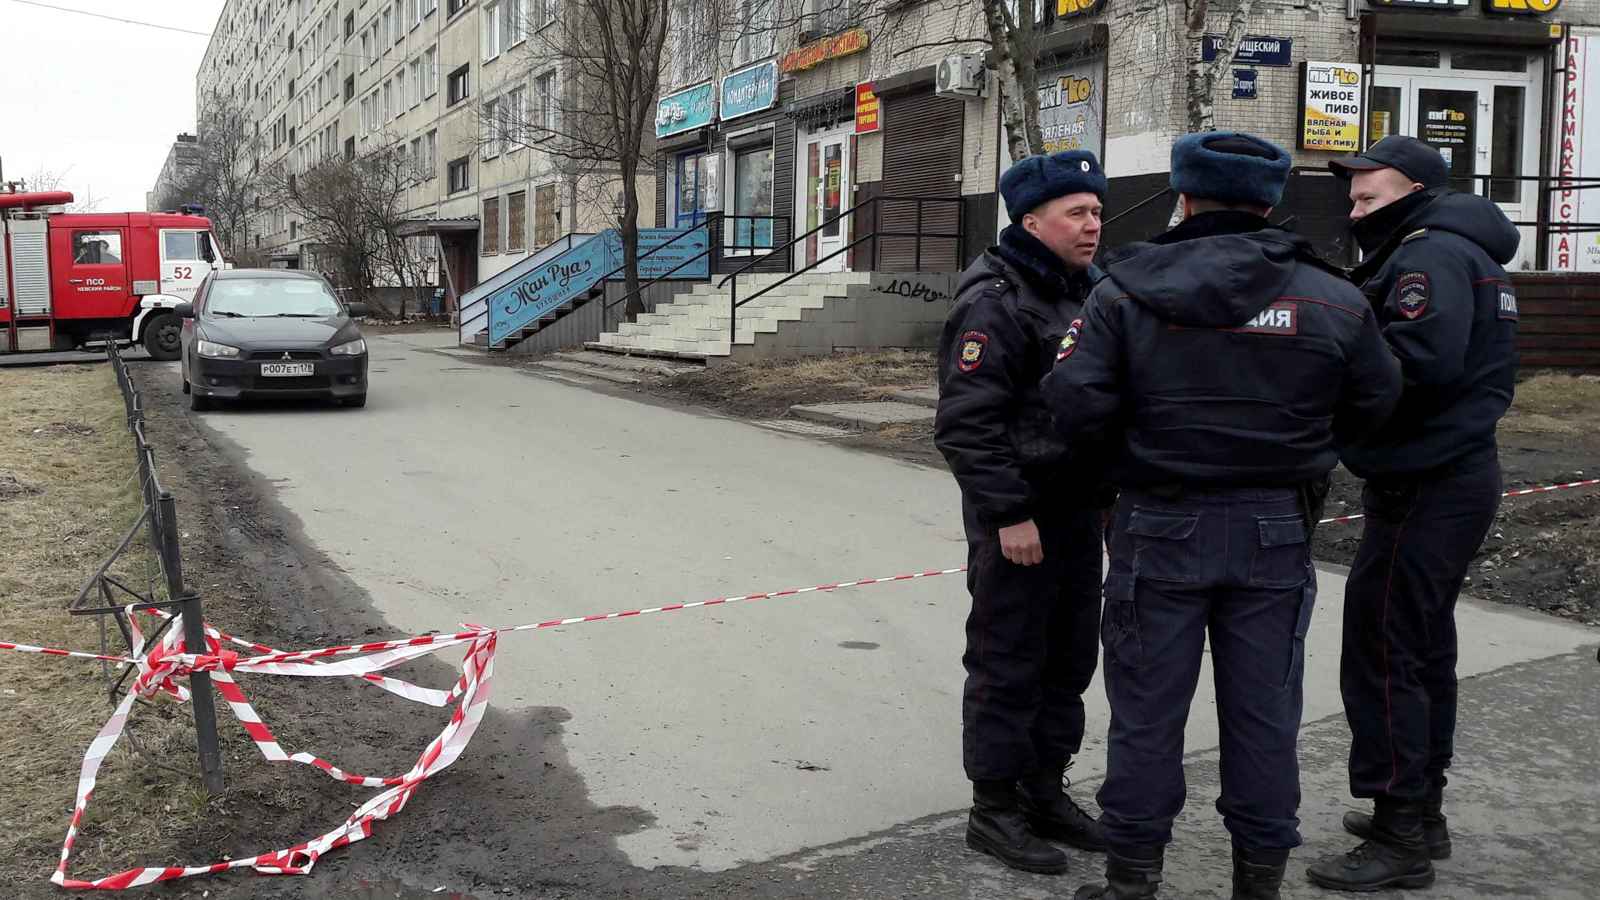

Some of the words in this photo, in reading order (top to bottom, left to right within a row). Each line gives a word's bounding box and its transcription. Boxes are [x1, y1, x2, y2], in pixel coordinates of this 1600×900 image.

[1212, 40, 1280, 53] ТОИЩЕСКИЙ
[1310, 90, 1355, 101] ЖИВОЕ
[1325, 104, 1359, 114] ПИВО
[1307, 119, 1347, 128] ВЯЛЕНАЯ
[1306, 129, 1331, 137] РЫБА
[174, 267, 193, 280] 52
[505, 275, 549, 315] Жан
[547, 260, 591, 287] Руа
